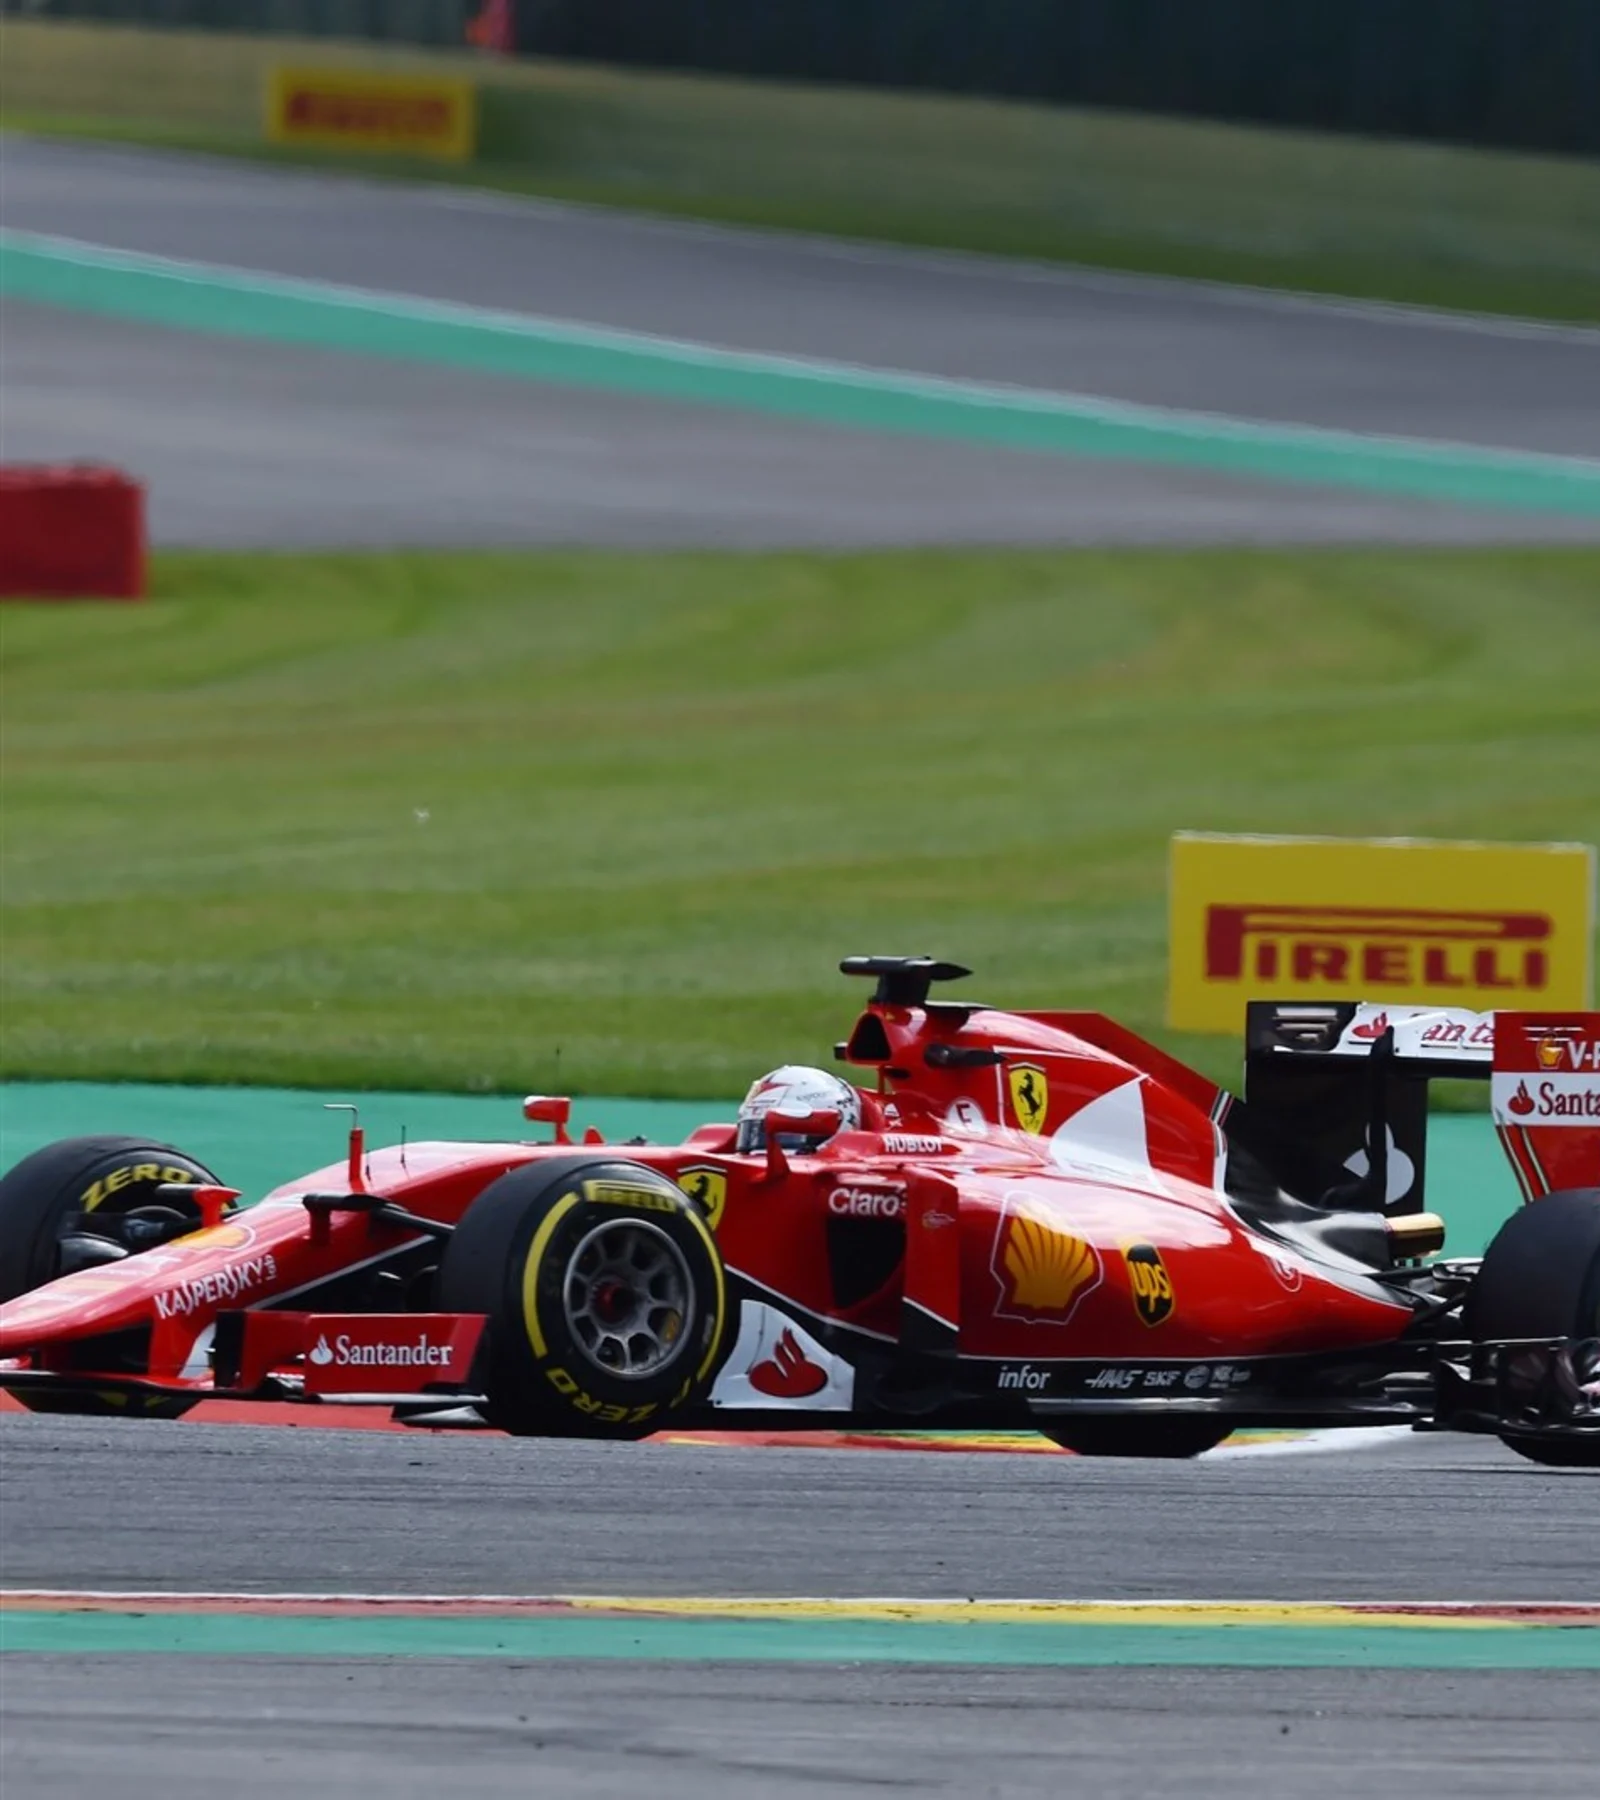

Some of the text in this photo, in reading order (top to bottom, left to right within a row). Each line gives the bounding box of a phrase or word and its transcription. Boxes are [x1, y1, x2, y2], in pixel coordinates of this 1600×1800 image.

[1204, 902, 1551, 989] PIRELLI
[883, 1135, 943, 1153] HUBLOT
[80, 1163, 194, 1213] ZERO
[829, 1186, 899, 1217] Claro
[1130, 1258, 1169, 1313] ups
[335, 1334, 453, 1367] Santander
[998, 1364, 1051, 1390] infor
[1143, 1371, 1180, 1386] SKF
